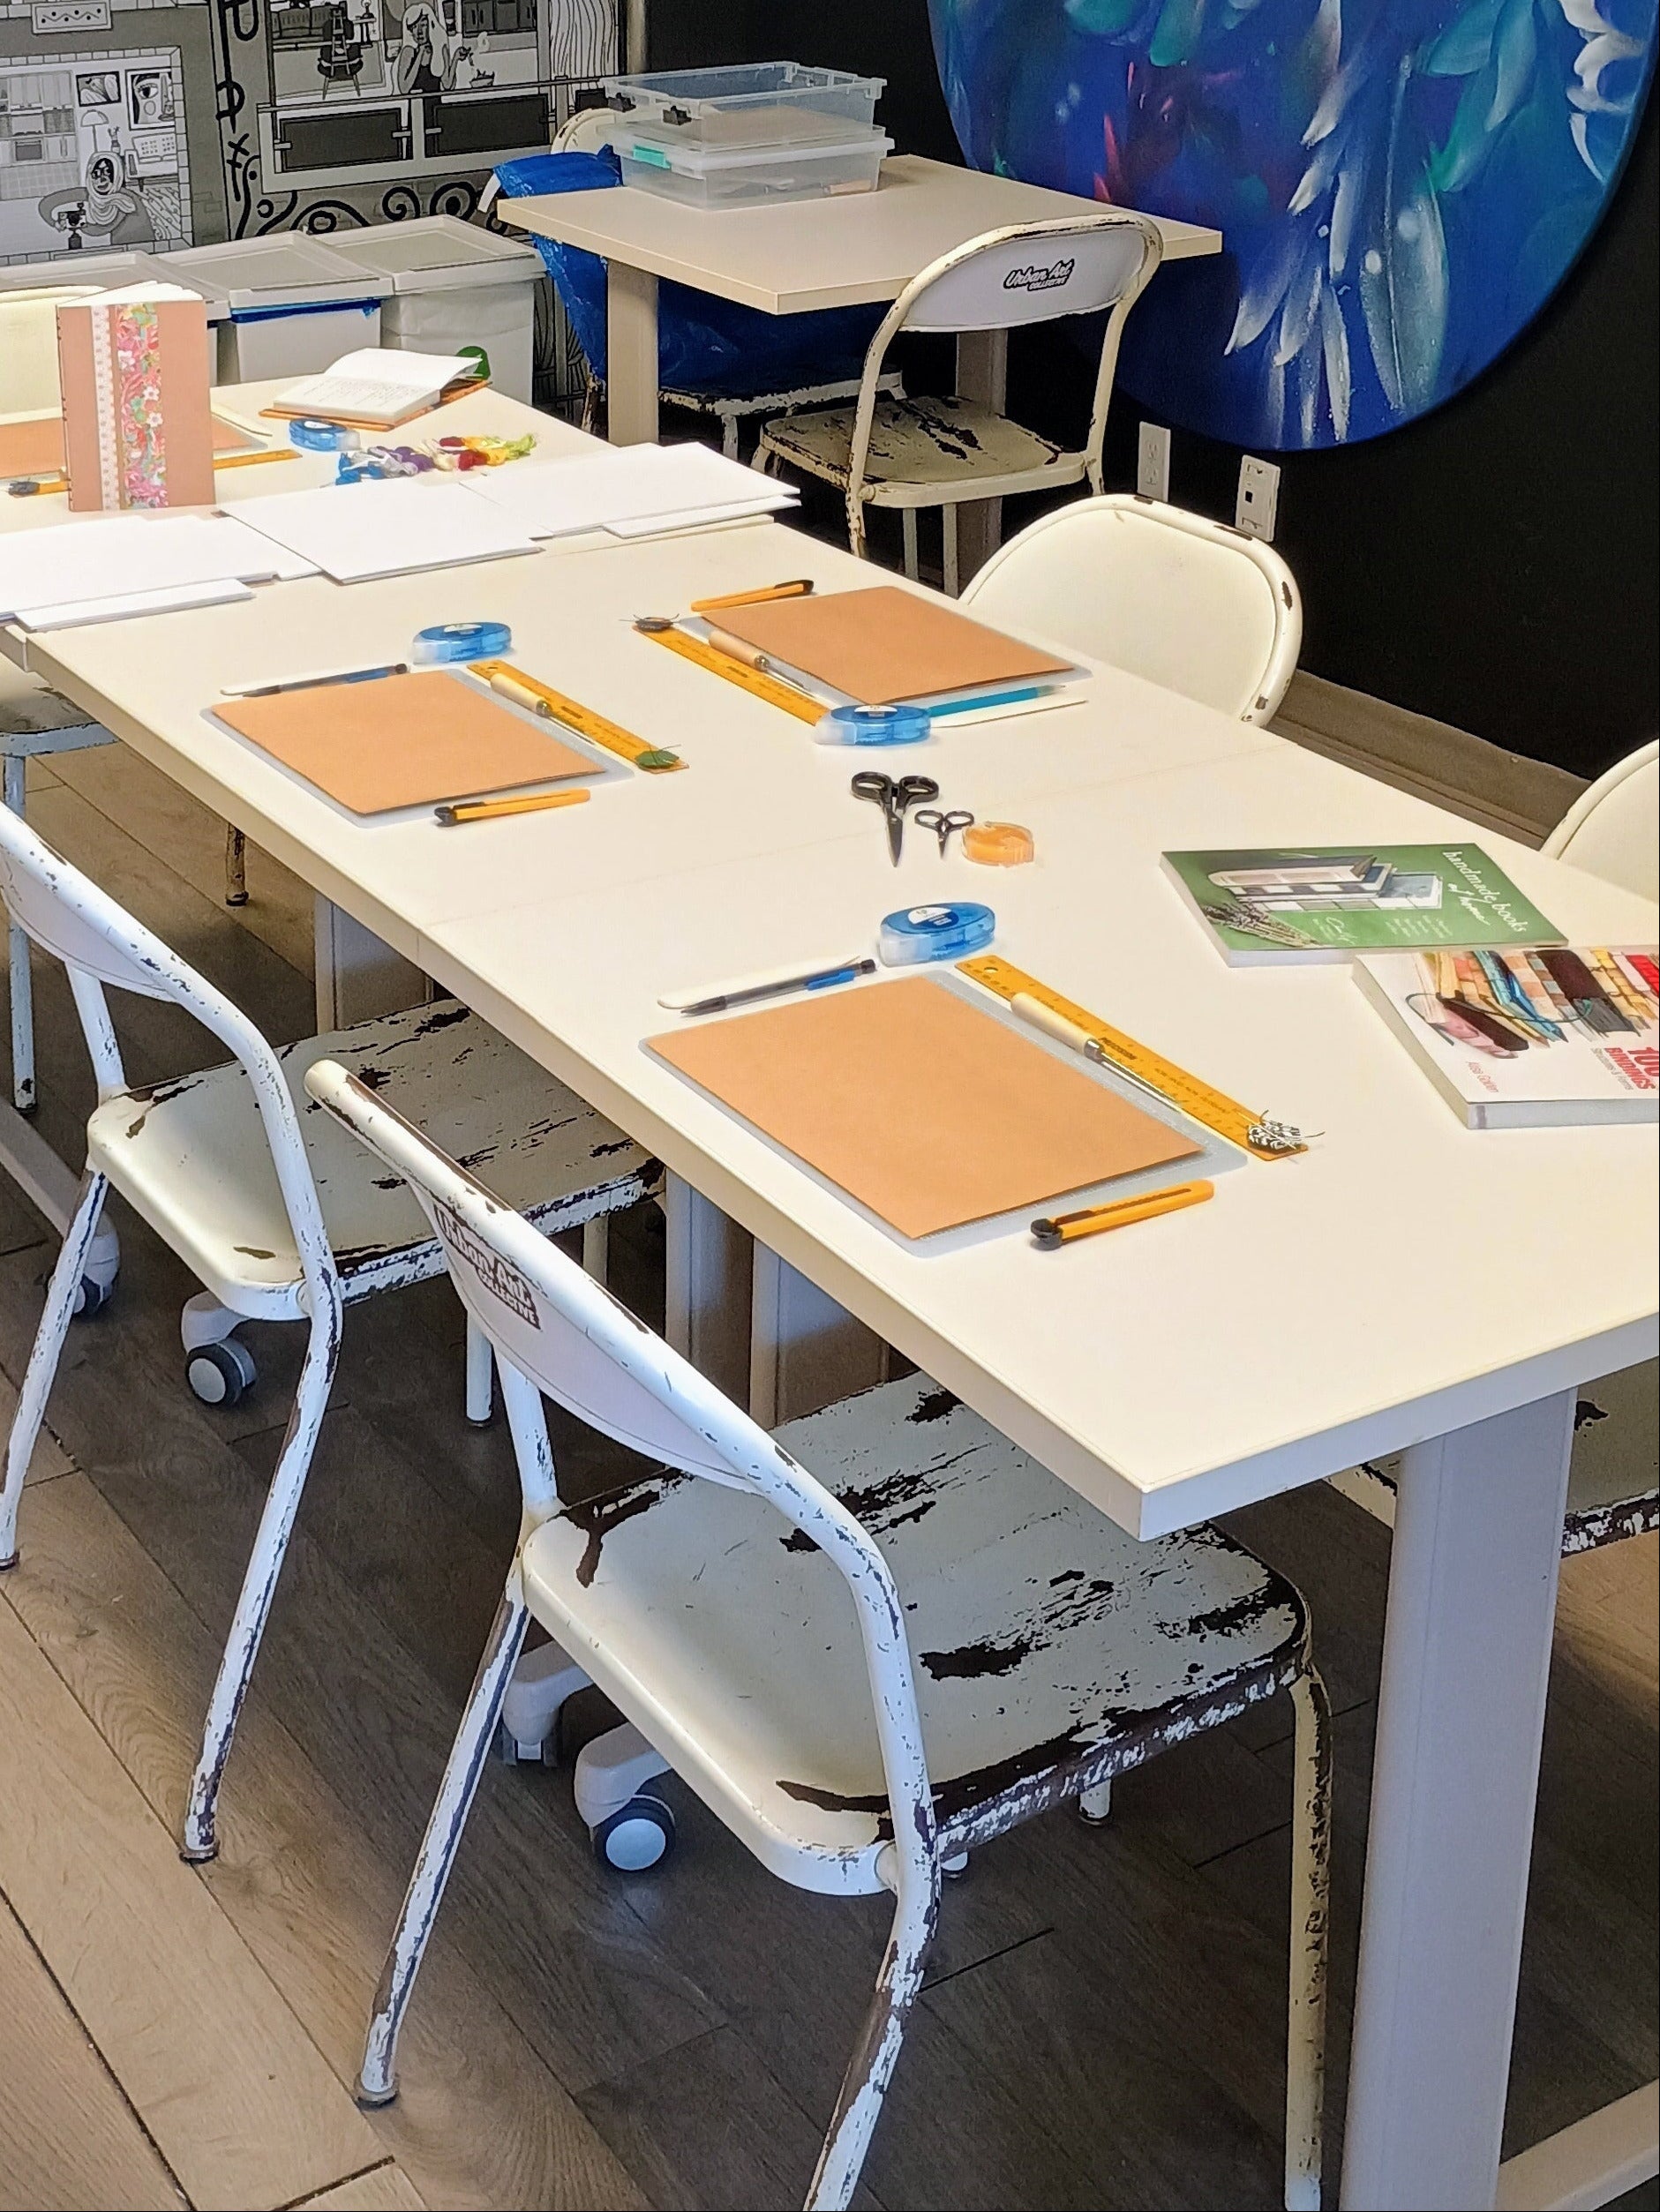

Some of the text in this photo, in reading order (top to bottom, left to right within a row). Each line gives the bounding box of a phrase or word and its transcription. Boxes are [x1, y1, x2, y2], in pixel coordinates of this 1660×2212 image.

[1003, 259, 1074, 289] Urban Art
[1442, 851, 1529, 932] handmade books
[1604, 1047, 1656, 1090] BINDINGS
[434, 1204, 536, 1308] Urban Art
